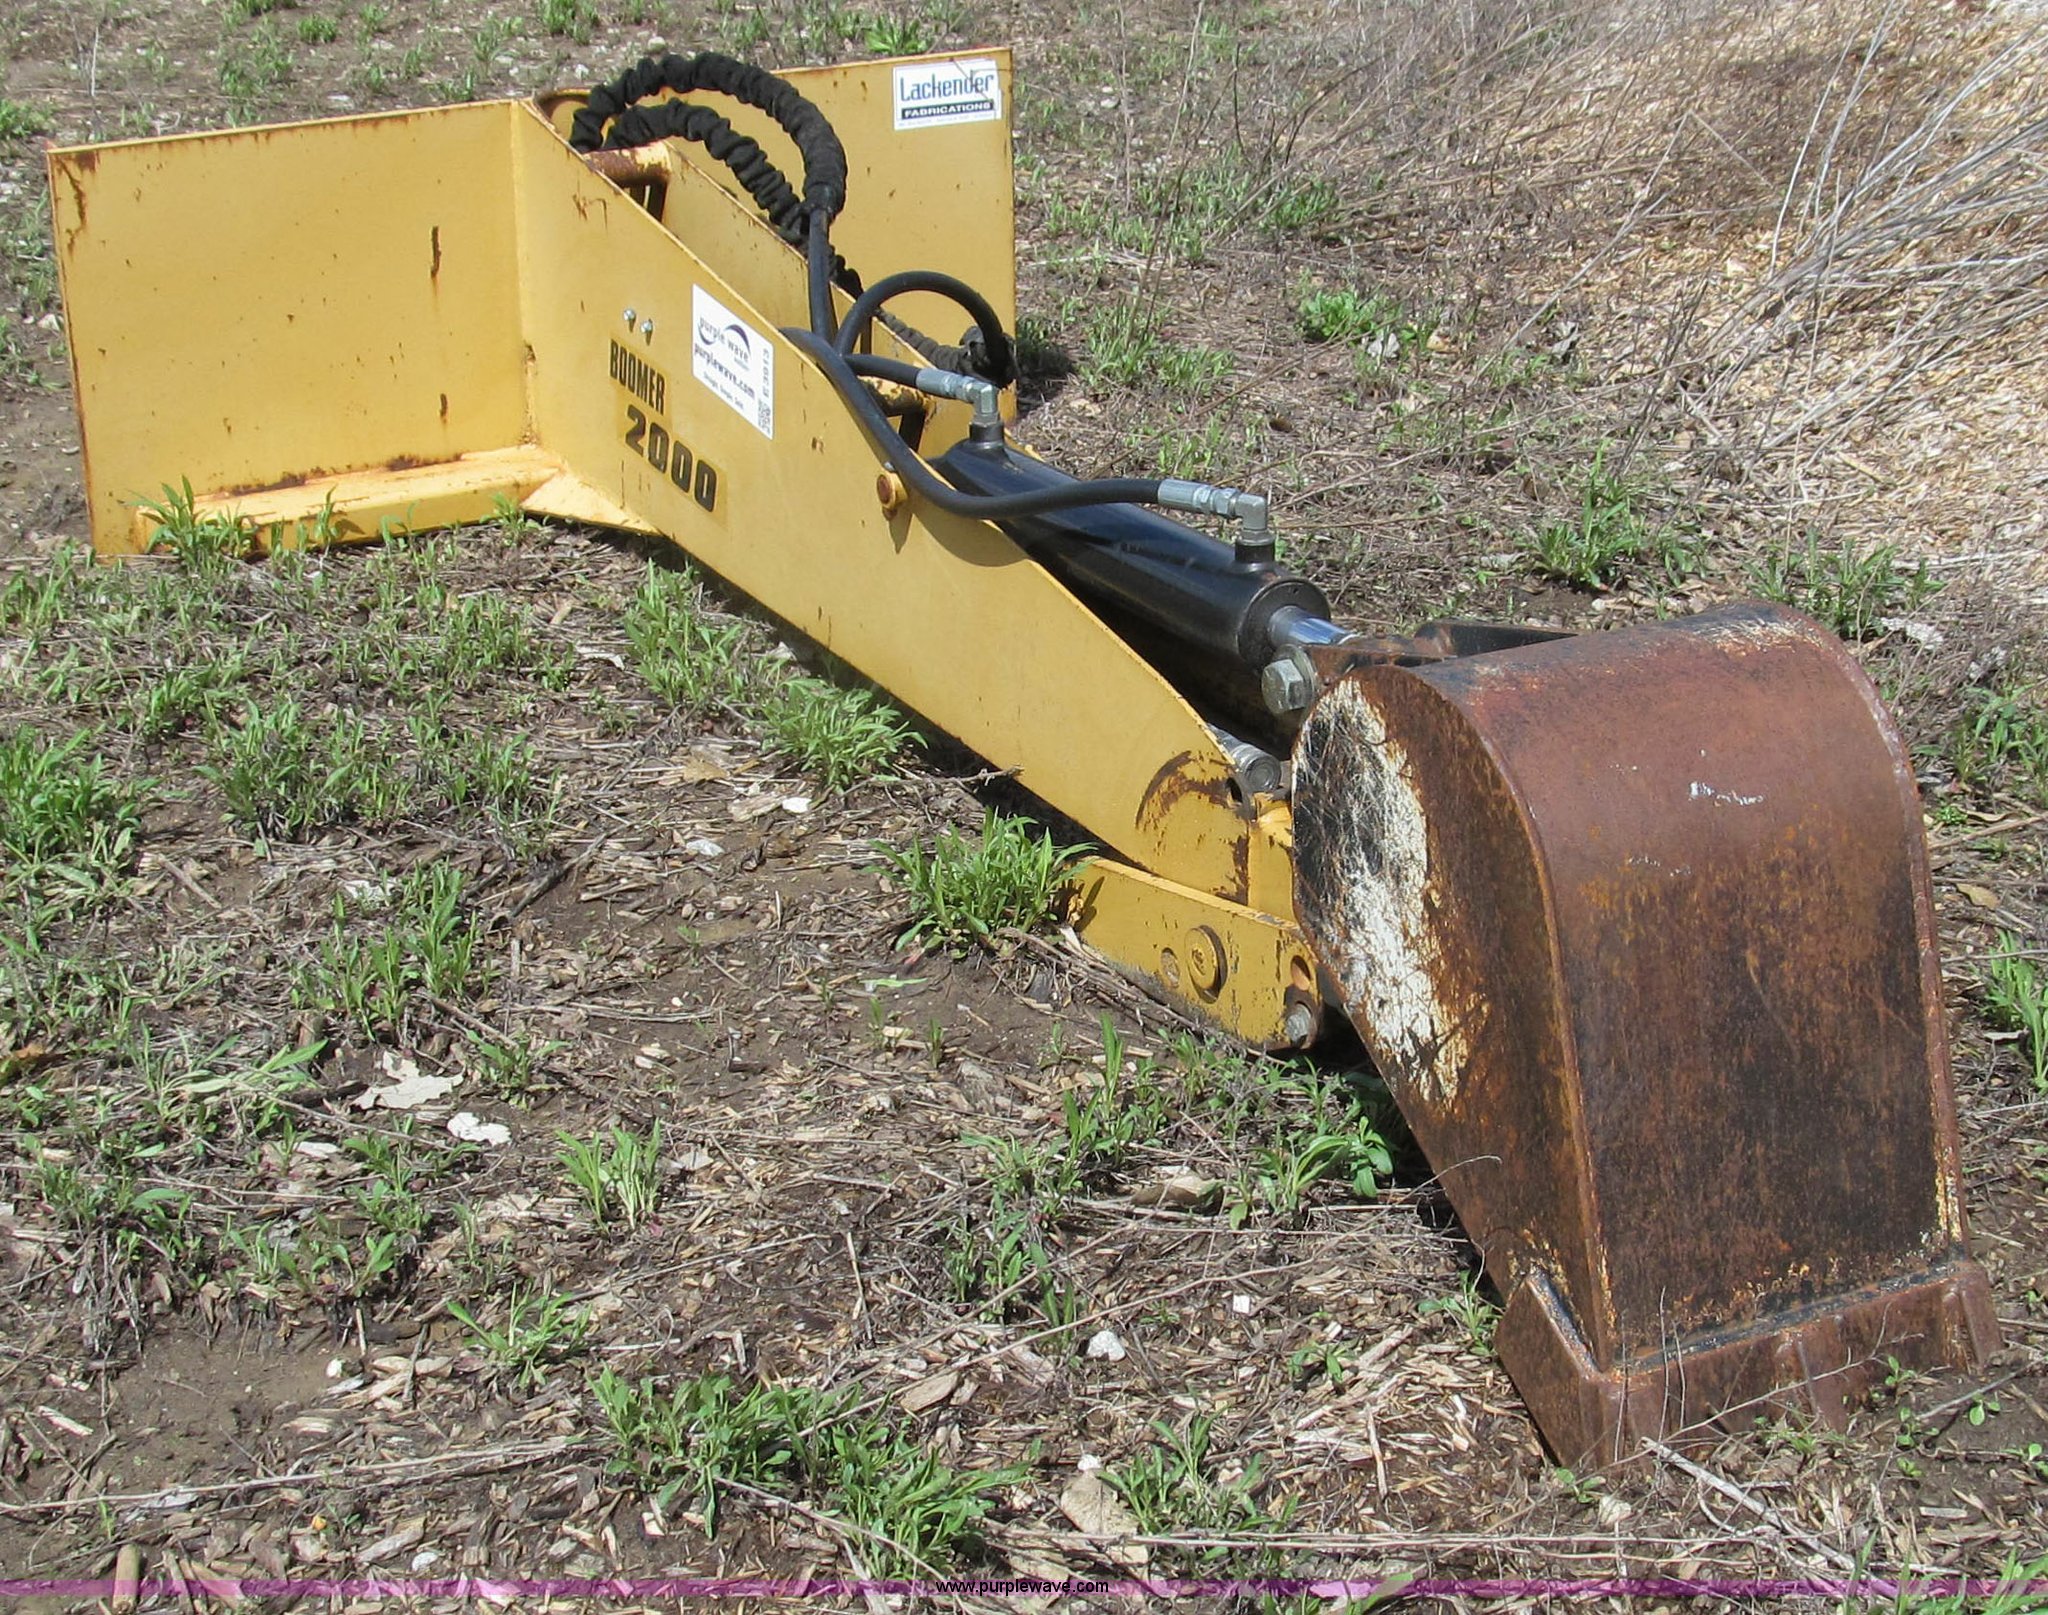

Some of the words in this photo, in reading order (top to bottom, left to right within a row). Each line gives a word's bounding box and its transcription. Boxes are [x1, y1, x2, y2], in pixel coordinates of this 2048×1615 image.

[900, 69, 995, 102] Lackender
[904, 101, 991, 118] FABRICATIONS
[699, 316, 725, 345] purple
[727, 340, 749, 362] wave
[610, 338, 666, 416] BOOMER
[694, 343, 756, 401] purplewave.com
[625, 403, 718, 513] 2000
